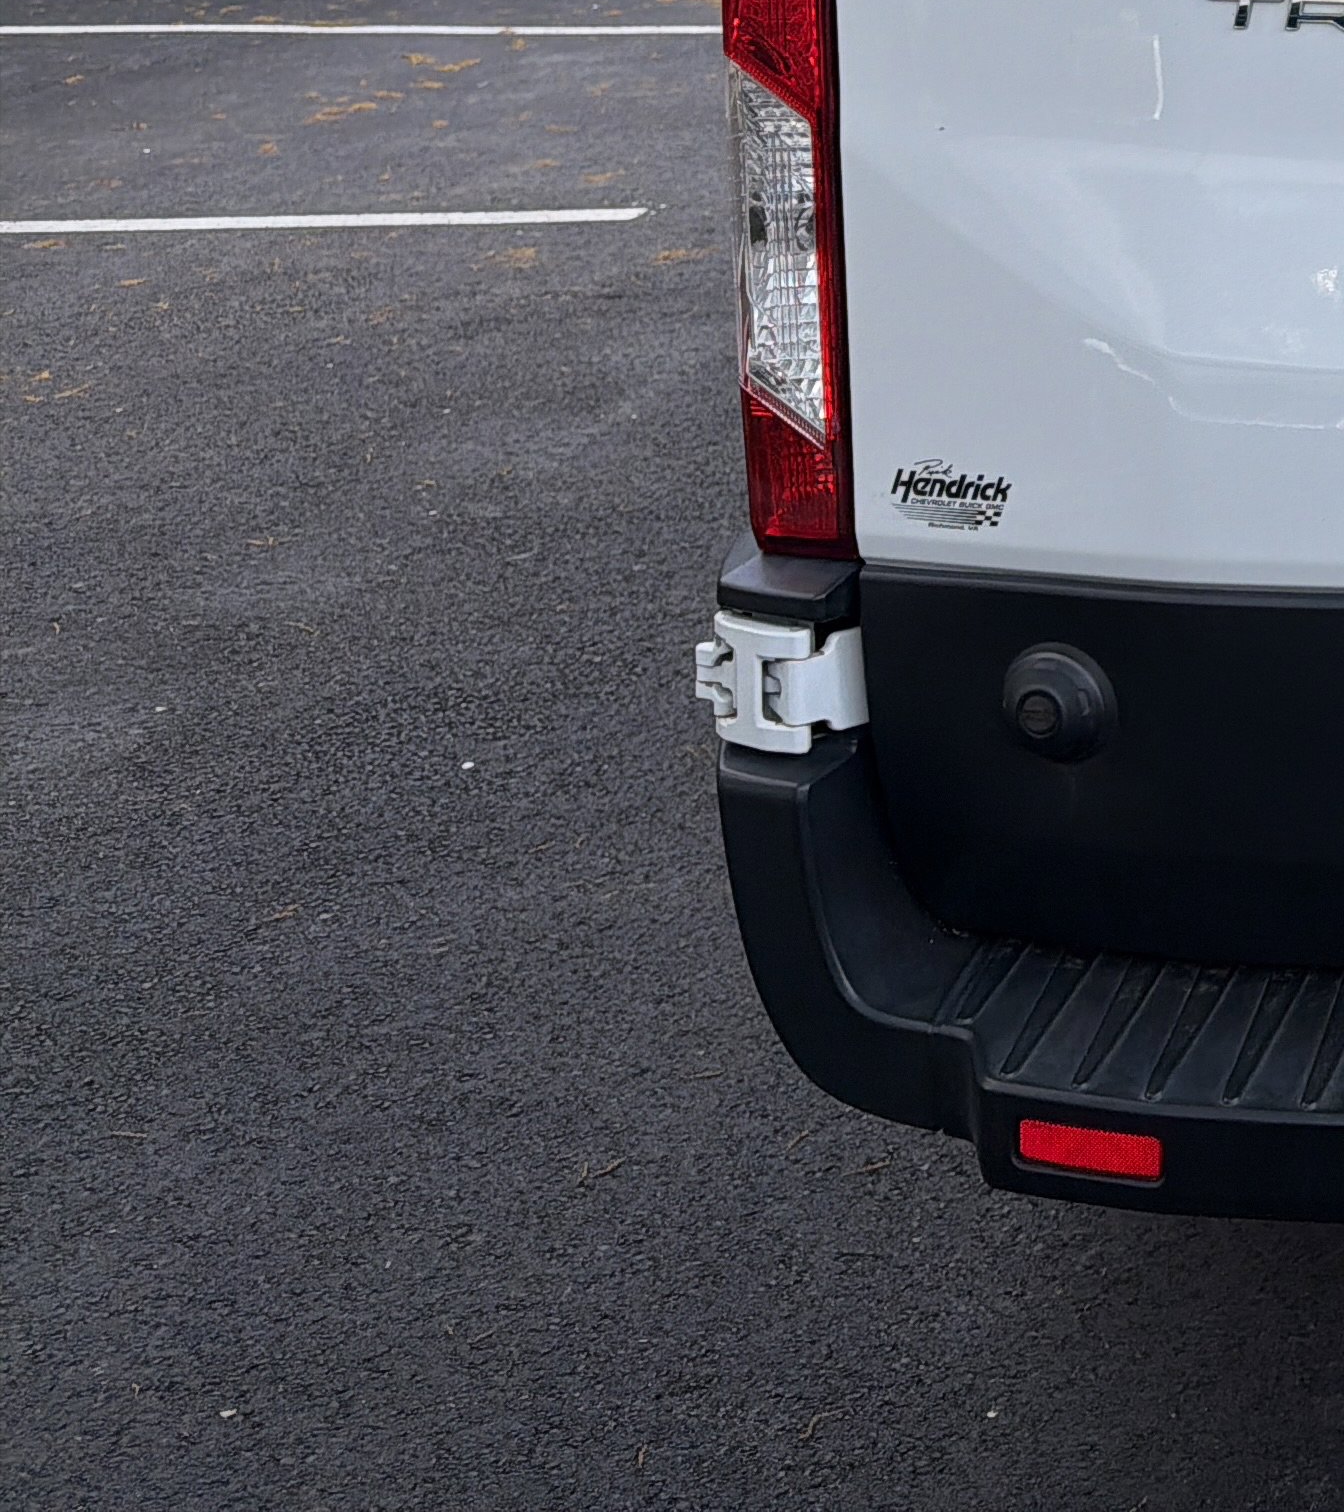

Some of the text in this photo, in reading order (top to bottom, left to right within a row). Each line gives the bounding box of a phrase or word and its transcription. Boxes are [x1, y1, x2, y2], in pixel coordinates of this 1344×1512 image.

[891, 468, 1012, 503] Hendrick
[911, 497, 957, 507] CHEVROLET
[959, 501, 983, 509] BUICK
